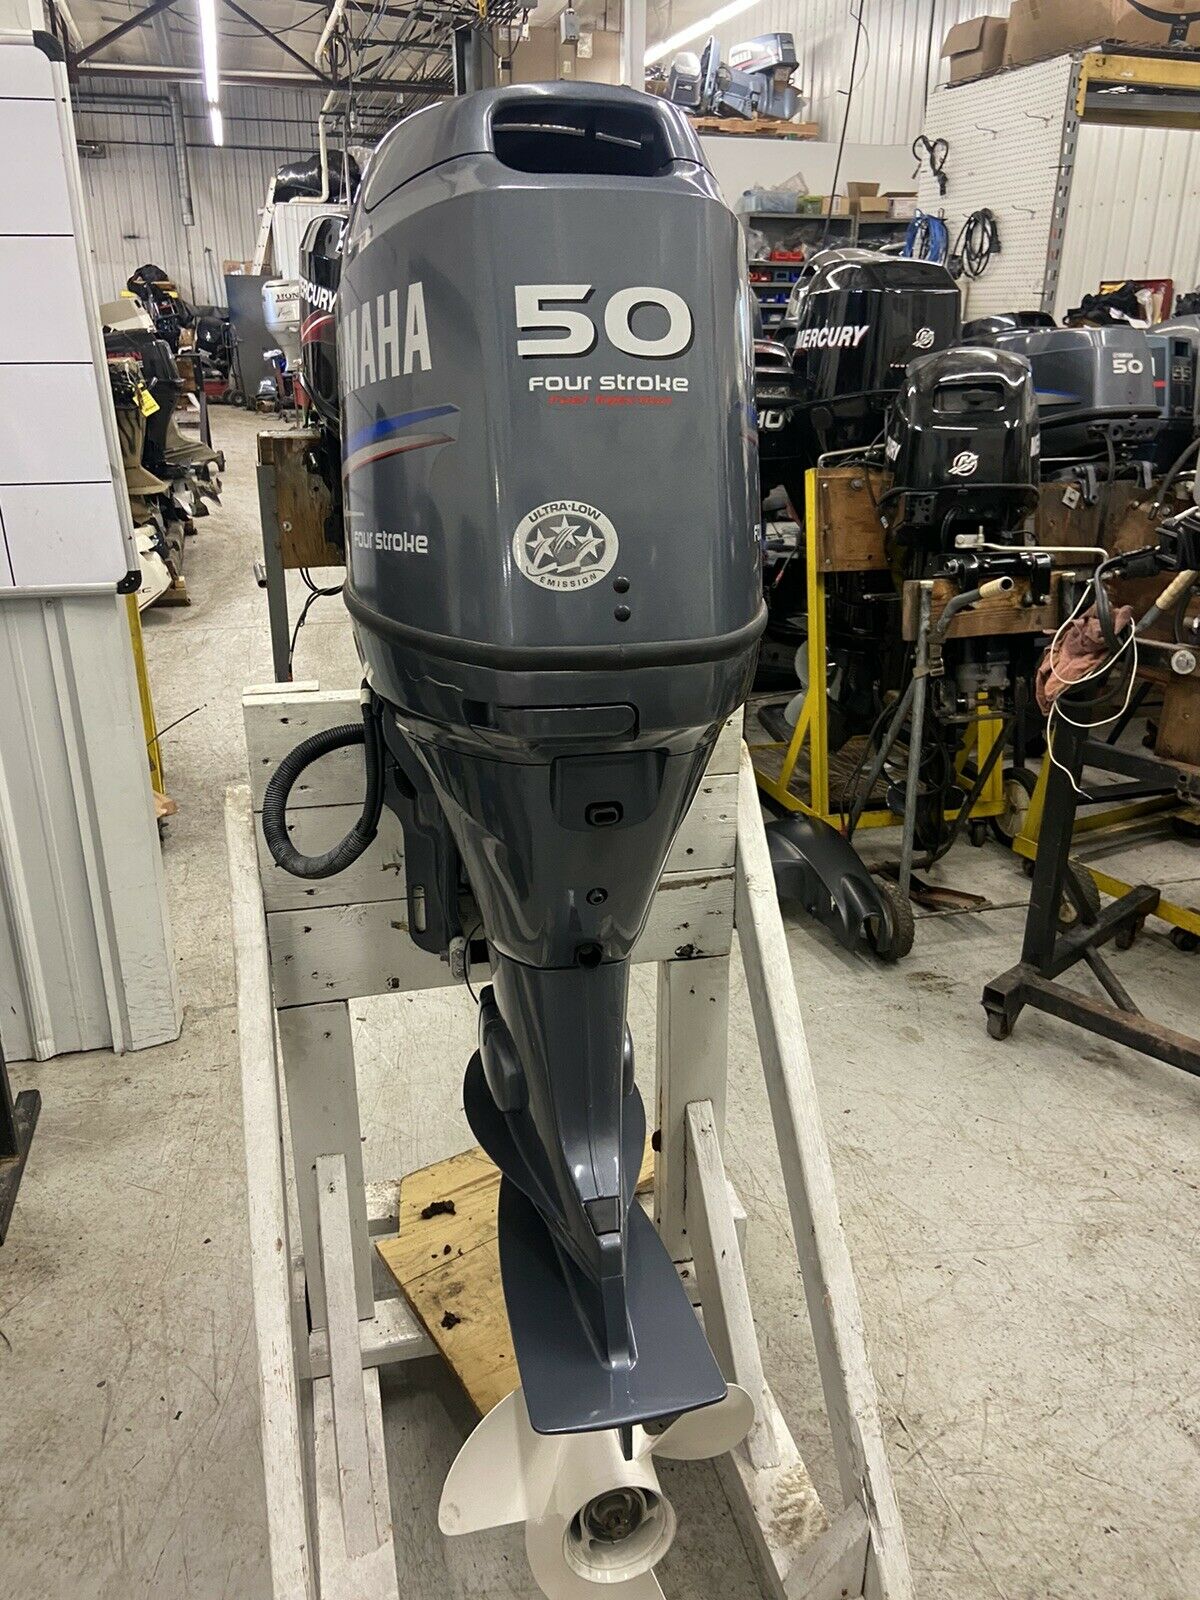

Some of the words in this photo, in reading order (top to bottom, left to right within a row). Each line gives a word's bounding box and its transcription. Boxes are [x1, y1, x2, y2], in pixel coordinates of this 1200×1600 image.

[514, 284, 694, 358] 50
[795, 325, 870, 348] MERCURY
[1112, 359, 1144, 374] 50
[540, 573, 597, 588] EMISSION
